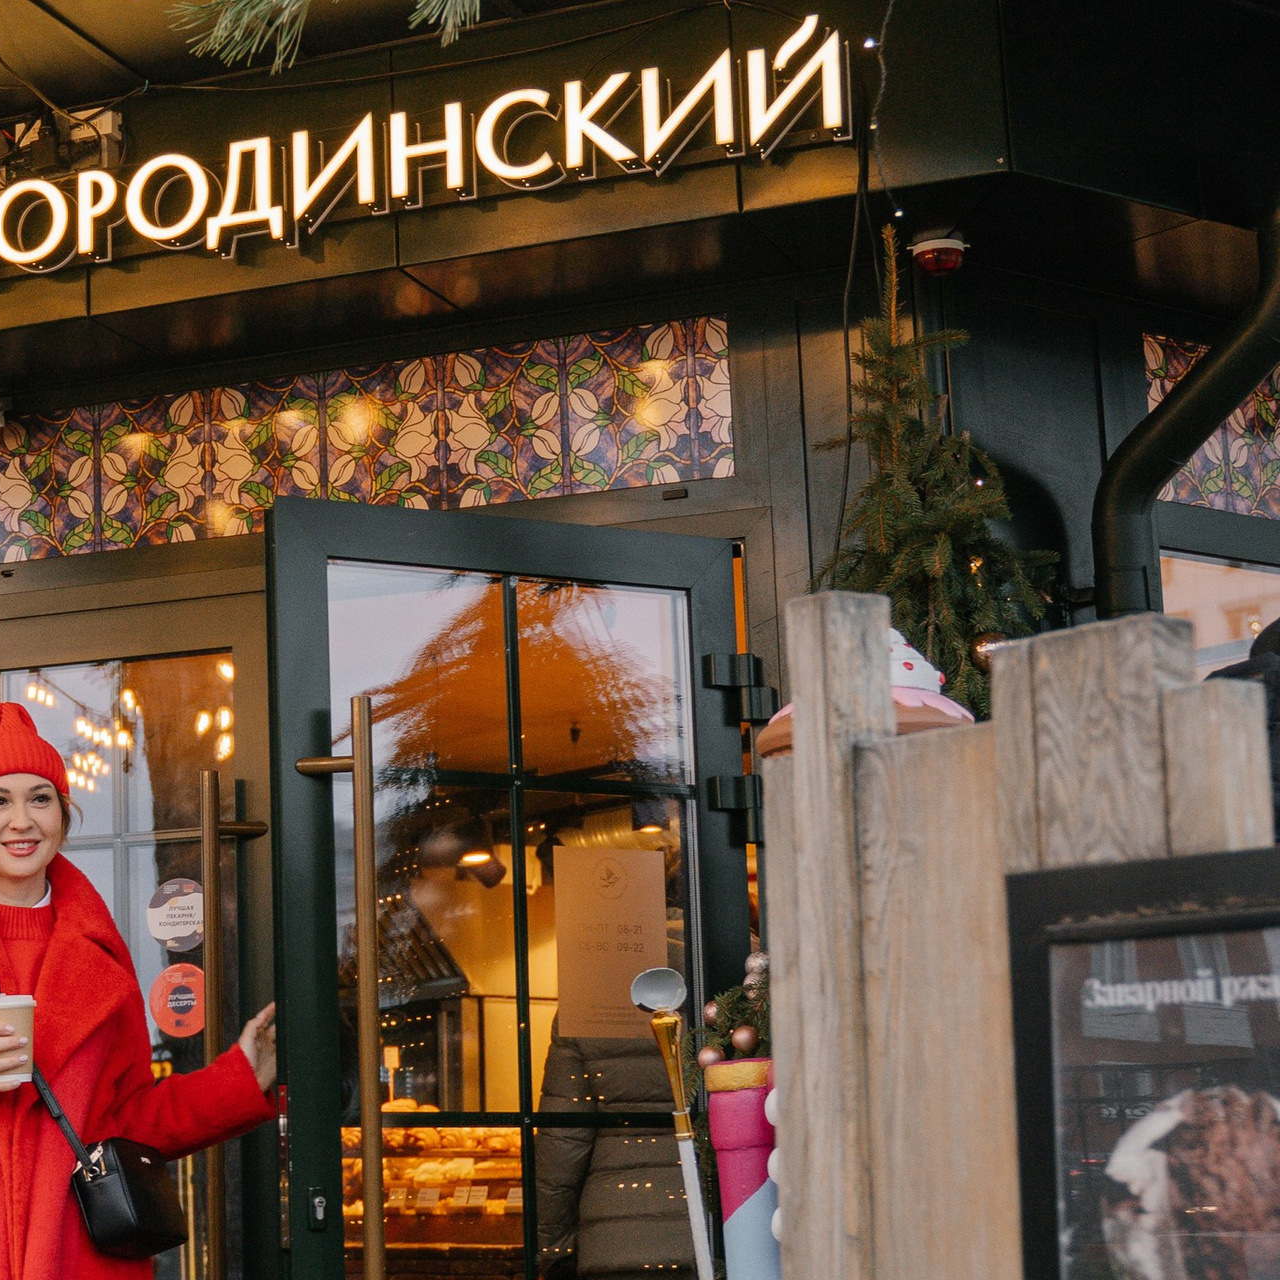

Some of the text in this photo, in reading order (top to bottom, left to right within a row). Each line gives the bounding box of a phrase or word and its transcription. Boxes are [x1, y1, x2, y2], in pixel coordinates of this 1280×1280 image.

[616, 924, 643, 935] 08-21
[616, 942, 644, 953] 09-22
[1081, 968, 1216, 1012] Заварной
